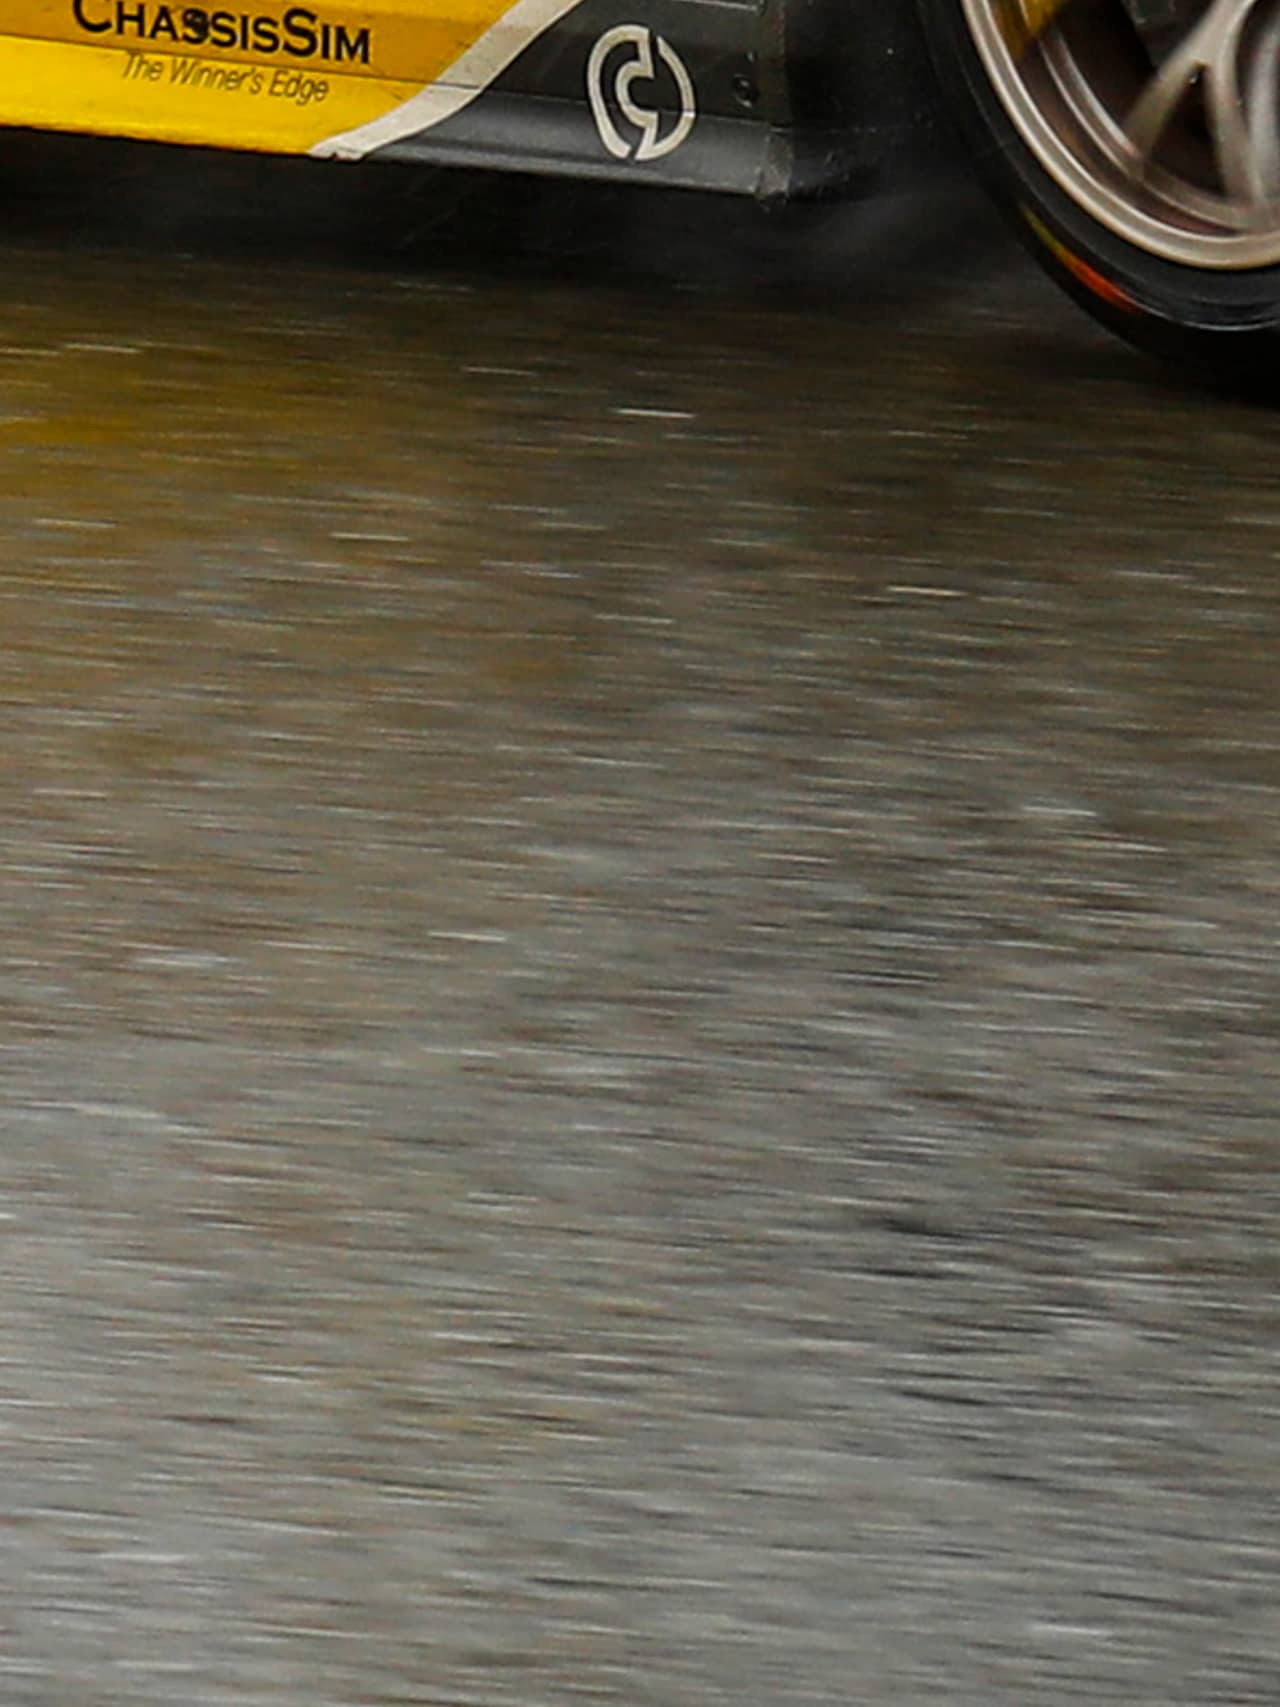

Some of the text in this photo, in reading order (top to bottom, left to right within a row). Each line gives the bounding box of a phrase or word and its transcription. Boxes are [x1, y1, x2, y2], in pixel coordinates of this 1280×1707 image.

[122, 49, 330, 107] The Winner's Edge
